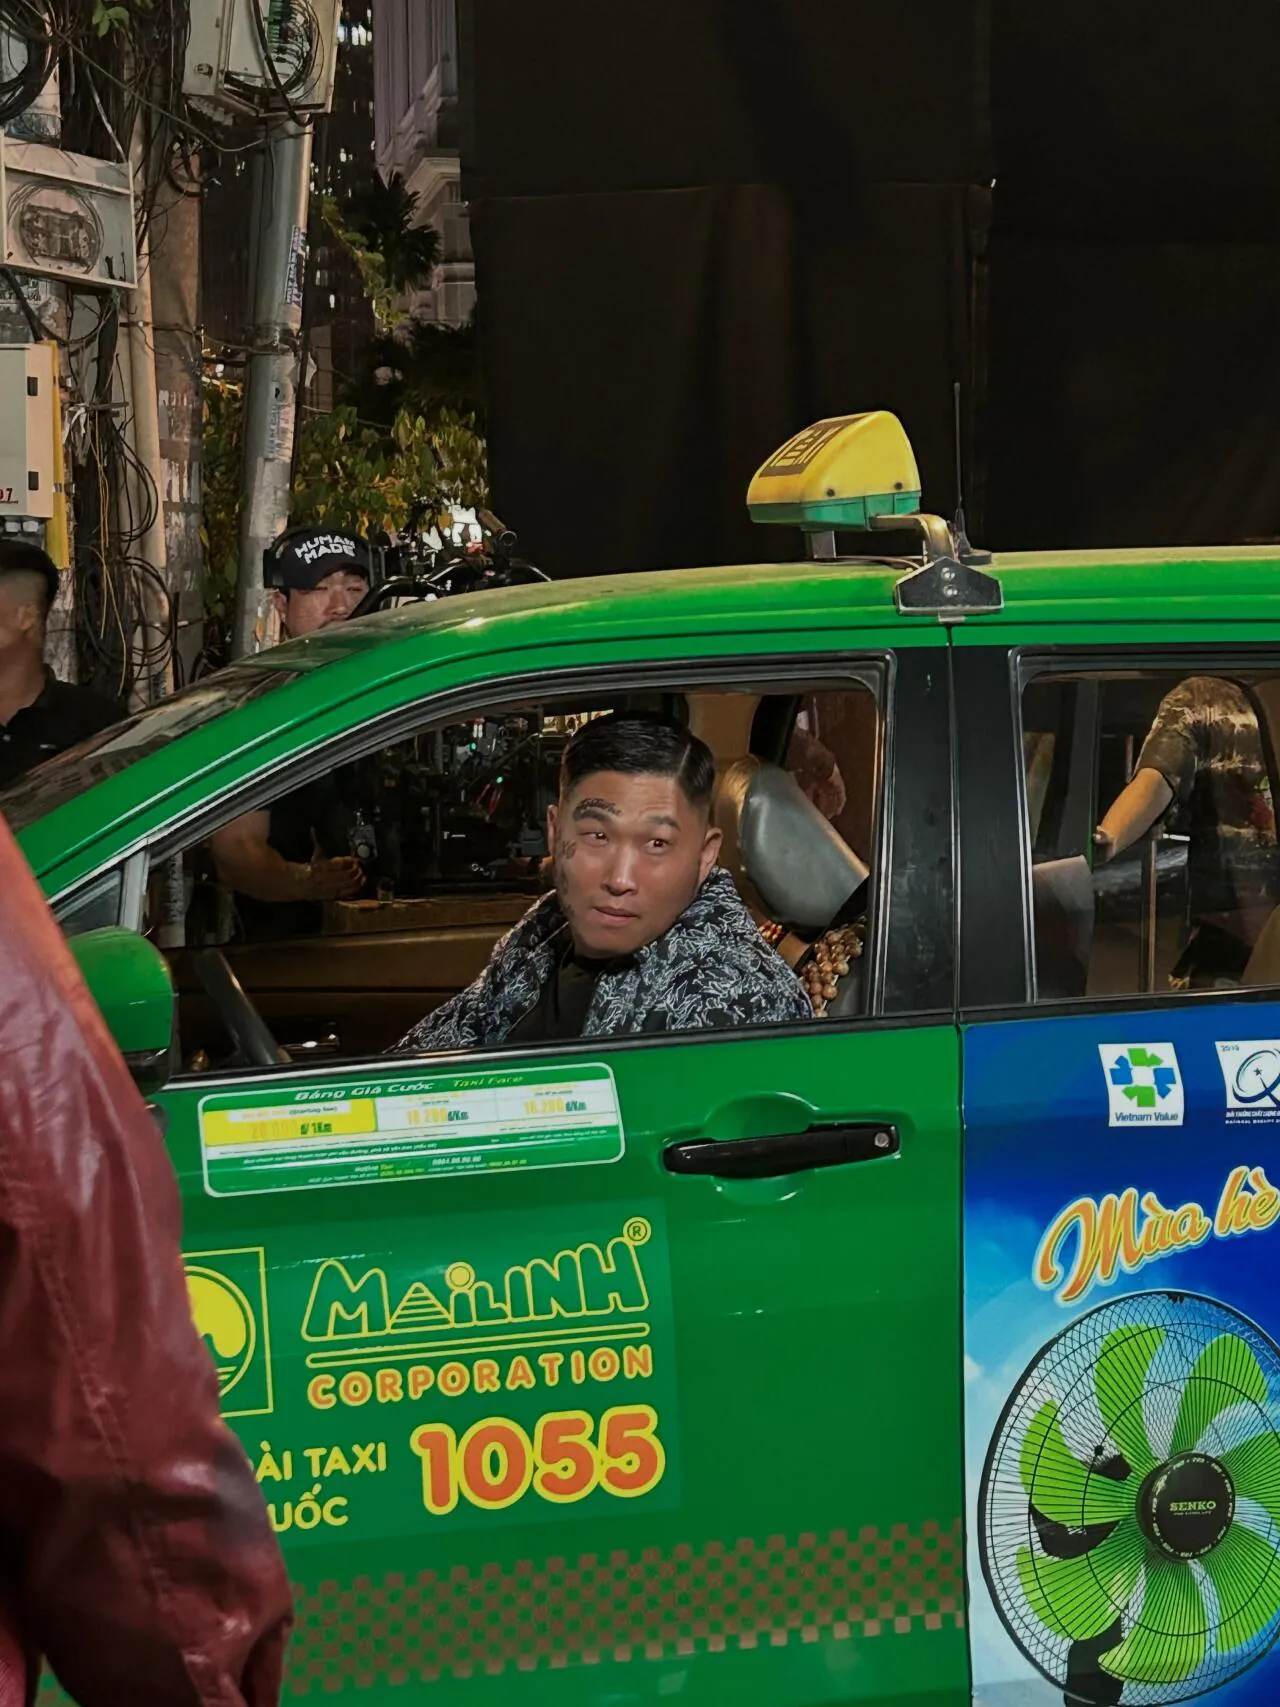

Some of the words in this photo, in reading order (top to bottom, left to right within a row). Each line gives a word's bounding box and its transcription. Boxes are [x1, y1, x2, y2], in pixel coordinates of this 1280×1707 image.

[294, 534, 356, 559] HUMAN
[304, 543, 356, 564] MADE
[452, 1078, 484, 1088] Taxi
[1115, 1112, 1152, 1121] Vietnam
[1154, 1112, 1179, 1121] Value
[1035, 1188, 1209, 1304] Mùa
[1216, 1166, 1280, 1236] hè
[306, 1344, 653, 1410] CORPORATION
[247, 1440, 293, 1483] ÀI
[303, 1441, 387, 1478] TAXI
[409, 1404, 666, 1516] 1055
[267, 1483, 348, 1532] UỐC
[1169, 1500, 1217, 1512] SENKO
